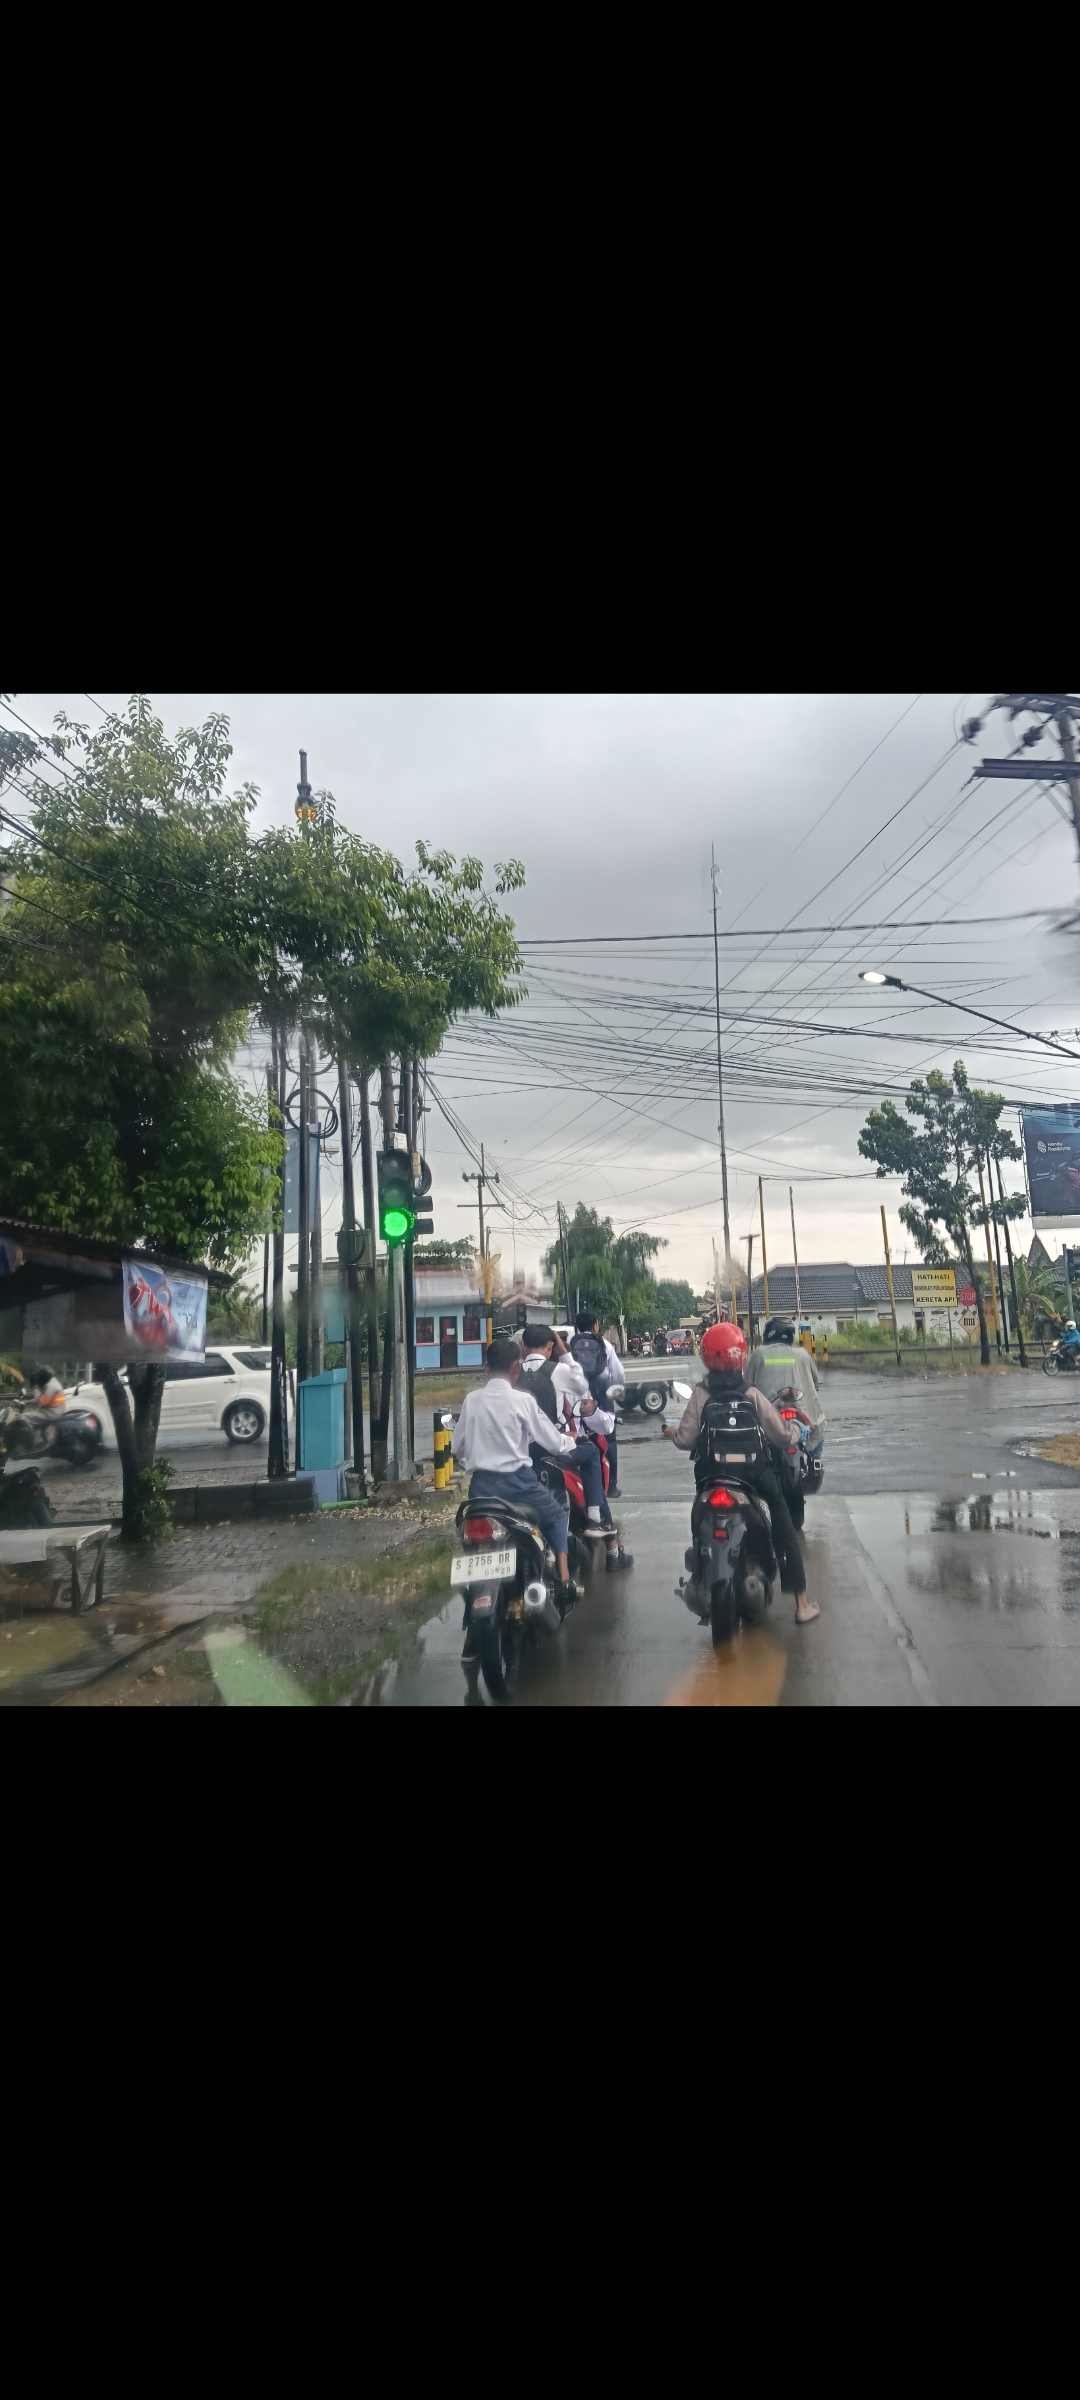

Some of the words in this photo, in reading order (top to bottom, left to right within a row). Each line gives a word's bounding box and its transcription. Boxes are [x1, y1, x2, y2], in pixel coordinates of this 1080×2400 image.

[960, 1292, 976, 1301] STOP
[456, 1560, 461, 1570] S
[469, 1556, 492, 1568] 2756
[498, 1552, 510, 1564] DR
